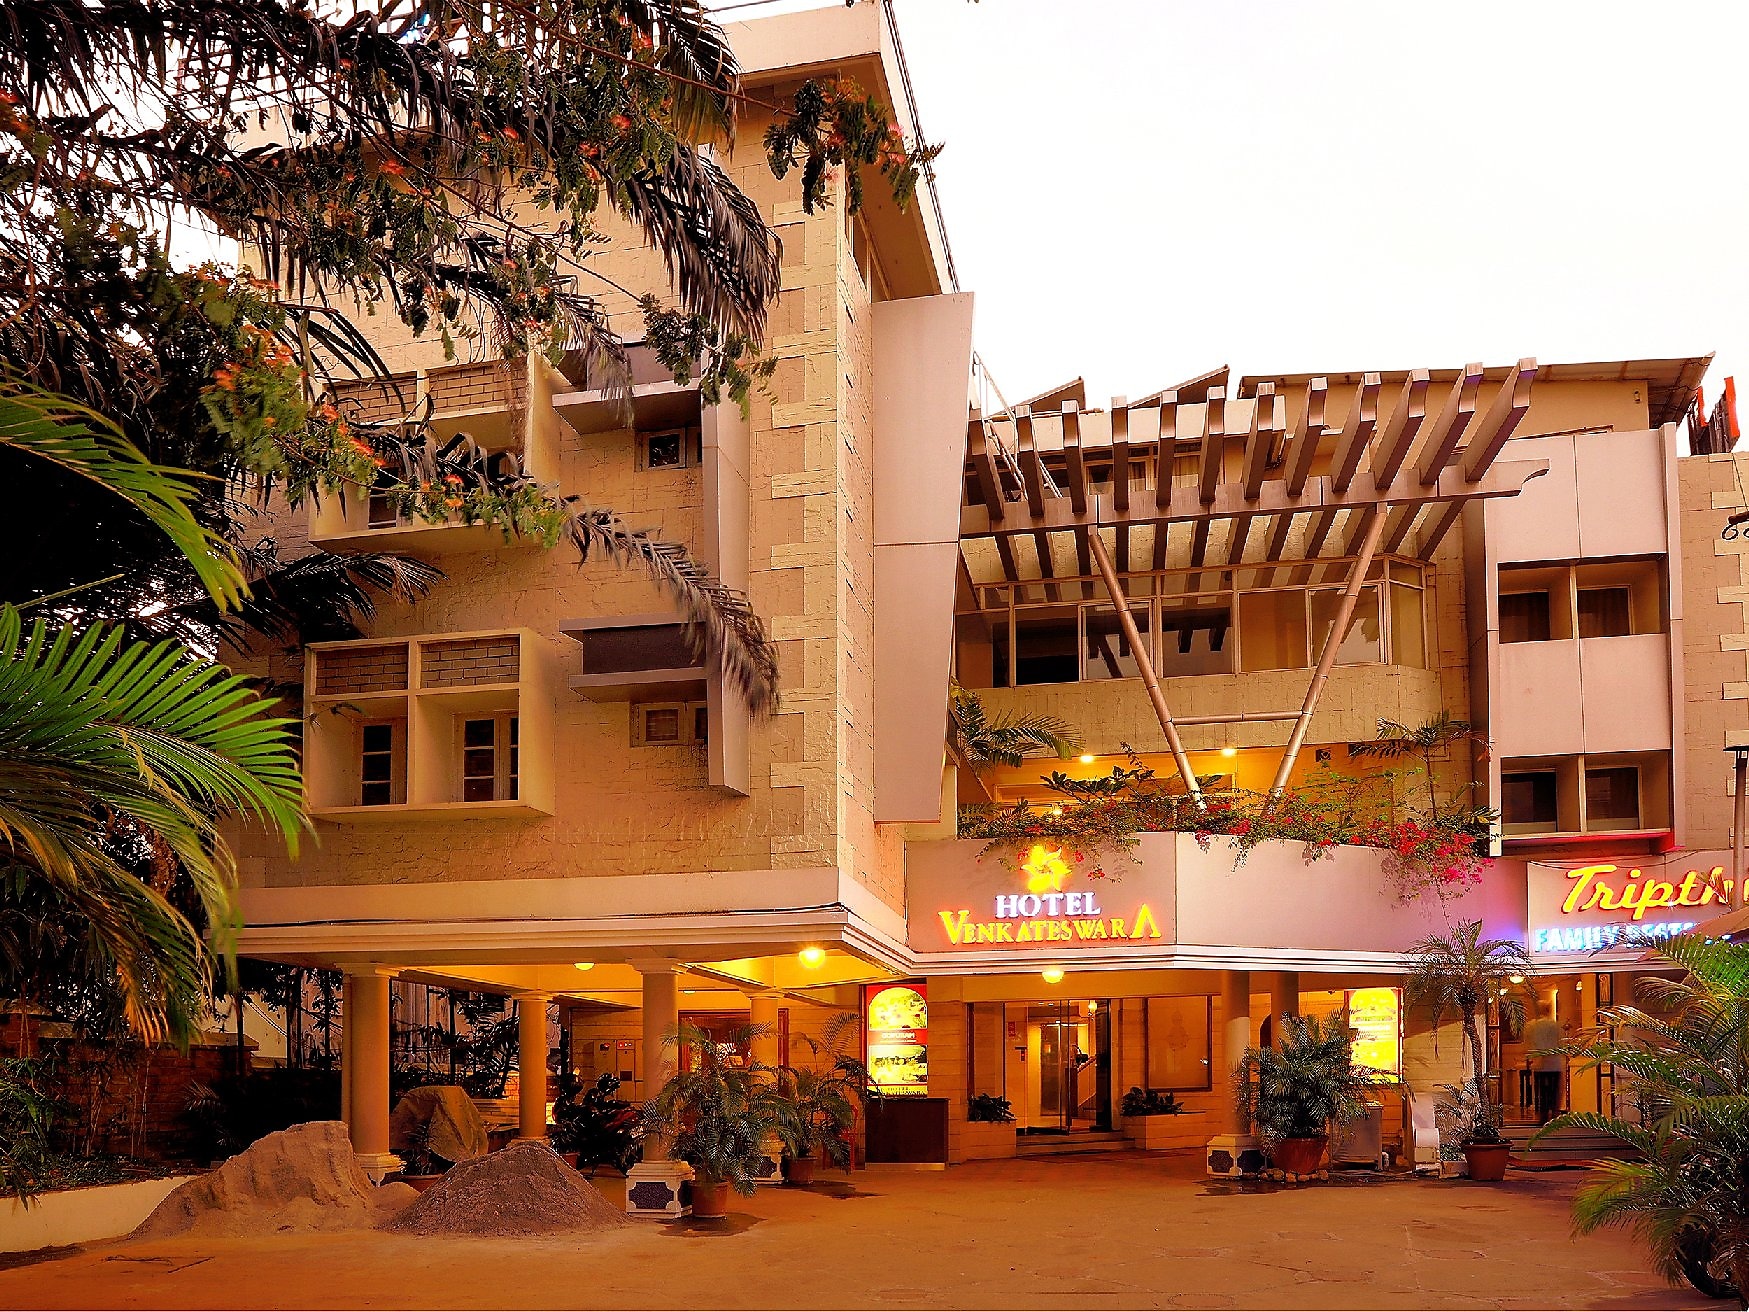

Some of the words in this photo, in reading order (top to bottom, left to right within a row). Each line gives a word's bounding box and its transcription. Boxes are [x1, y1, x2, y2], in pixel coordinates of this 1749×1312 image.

[996, 892, 1101, 918] HOTEL
[938, 904, 1161, 944] VENKATESWARA
[1535, 925, 1620, 952] FAMILY
